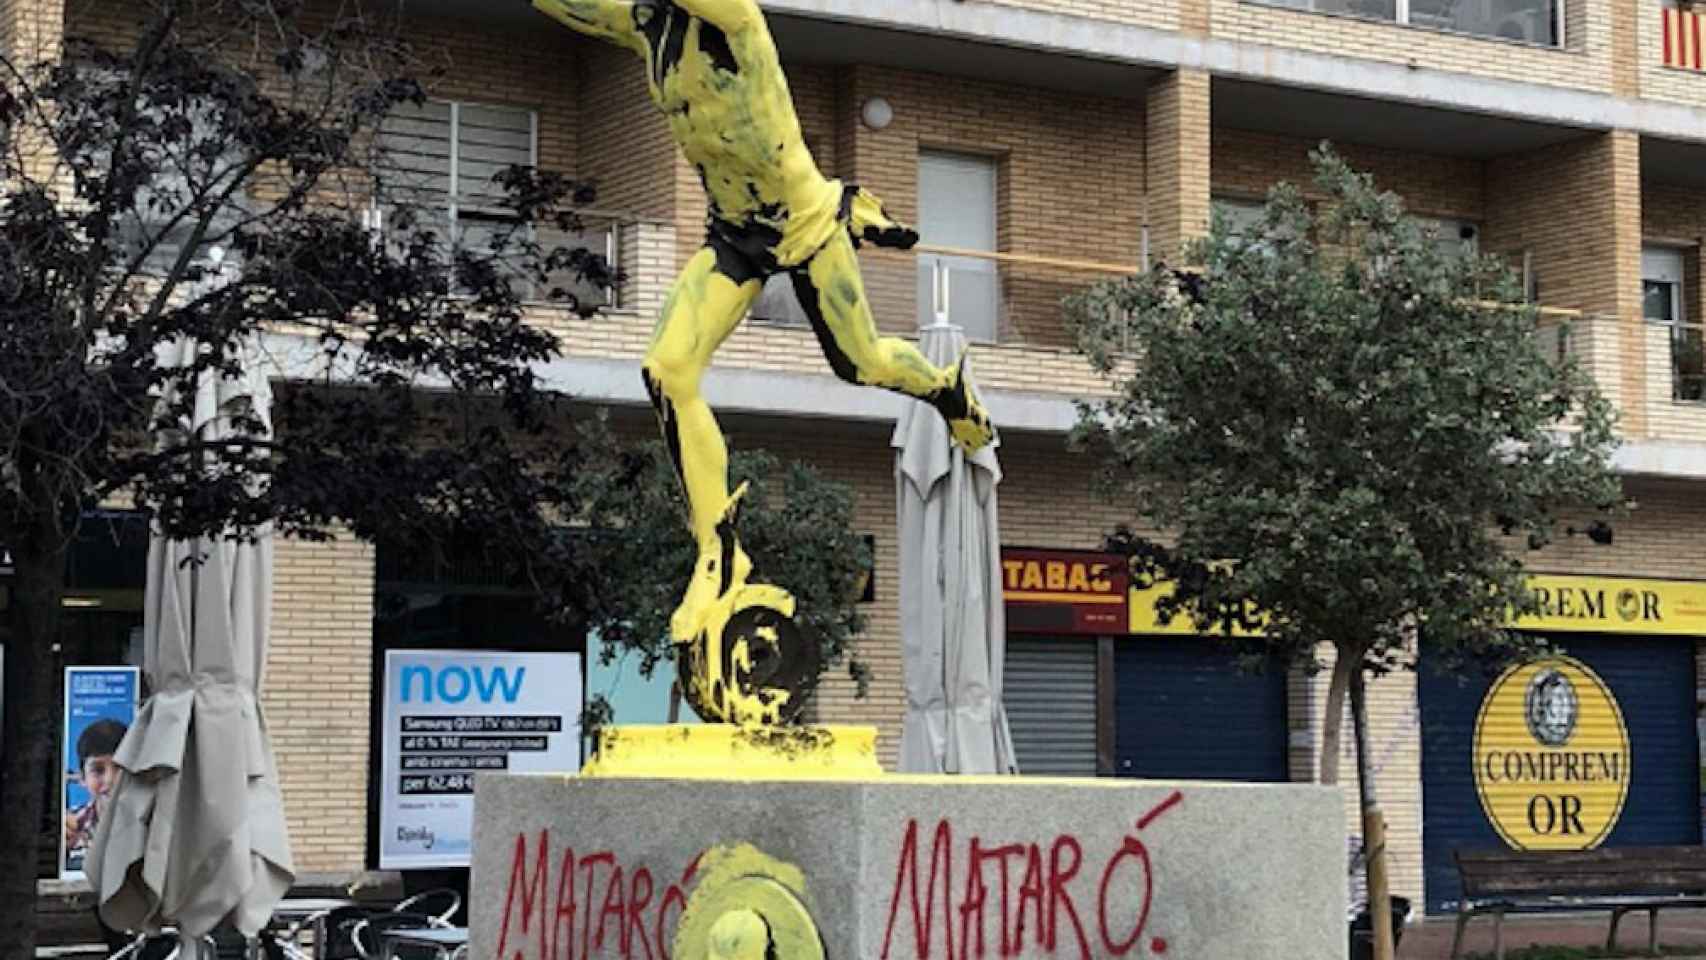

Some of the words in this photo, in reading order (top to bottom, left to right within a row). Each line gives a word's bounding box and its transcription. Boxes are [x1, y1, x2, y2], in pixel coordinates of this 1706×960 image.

[401, 664, 526, 703] now
[1486, 751, 1618, 781] COMPREM
[1527, 793, 1584, 834] OR
